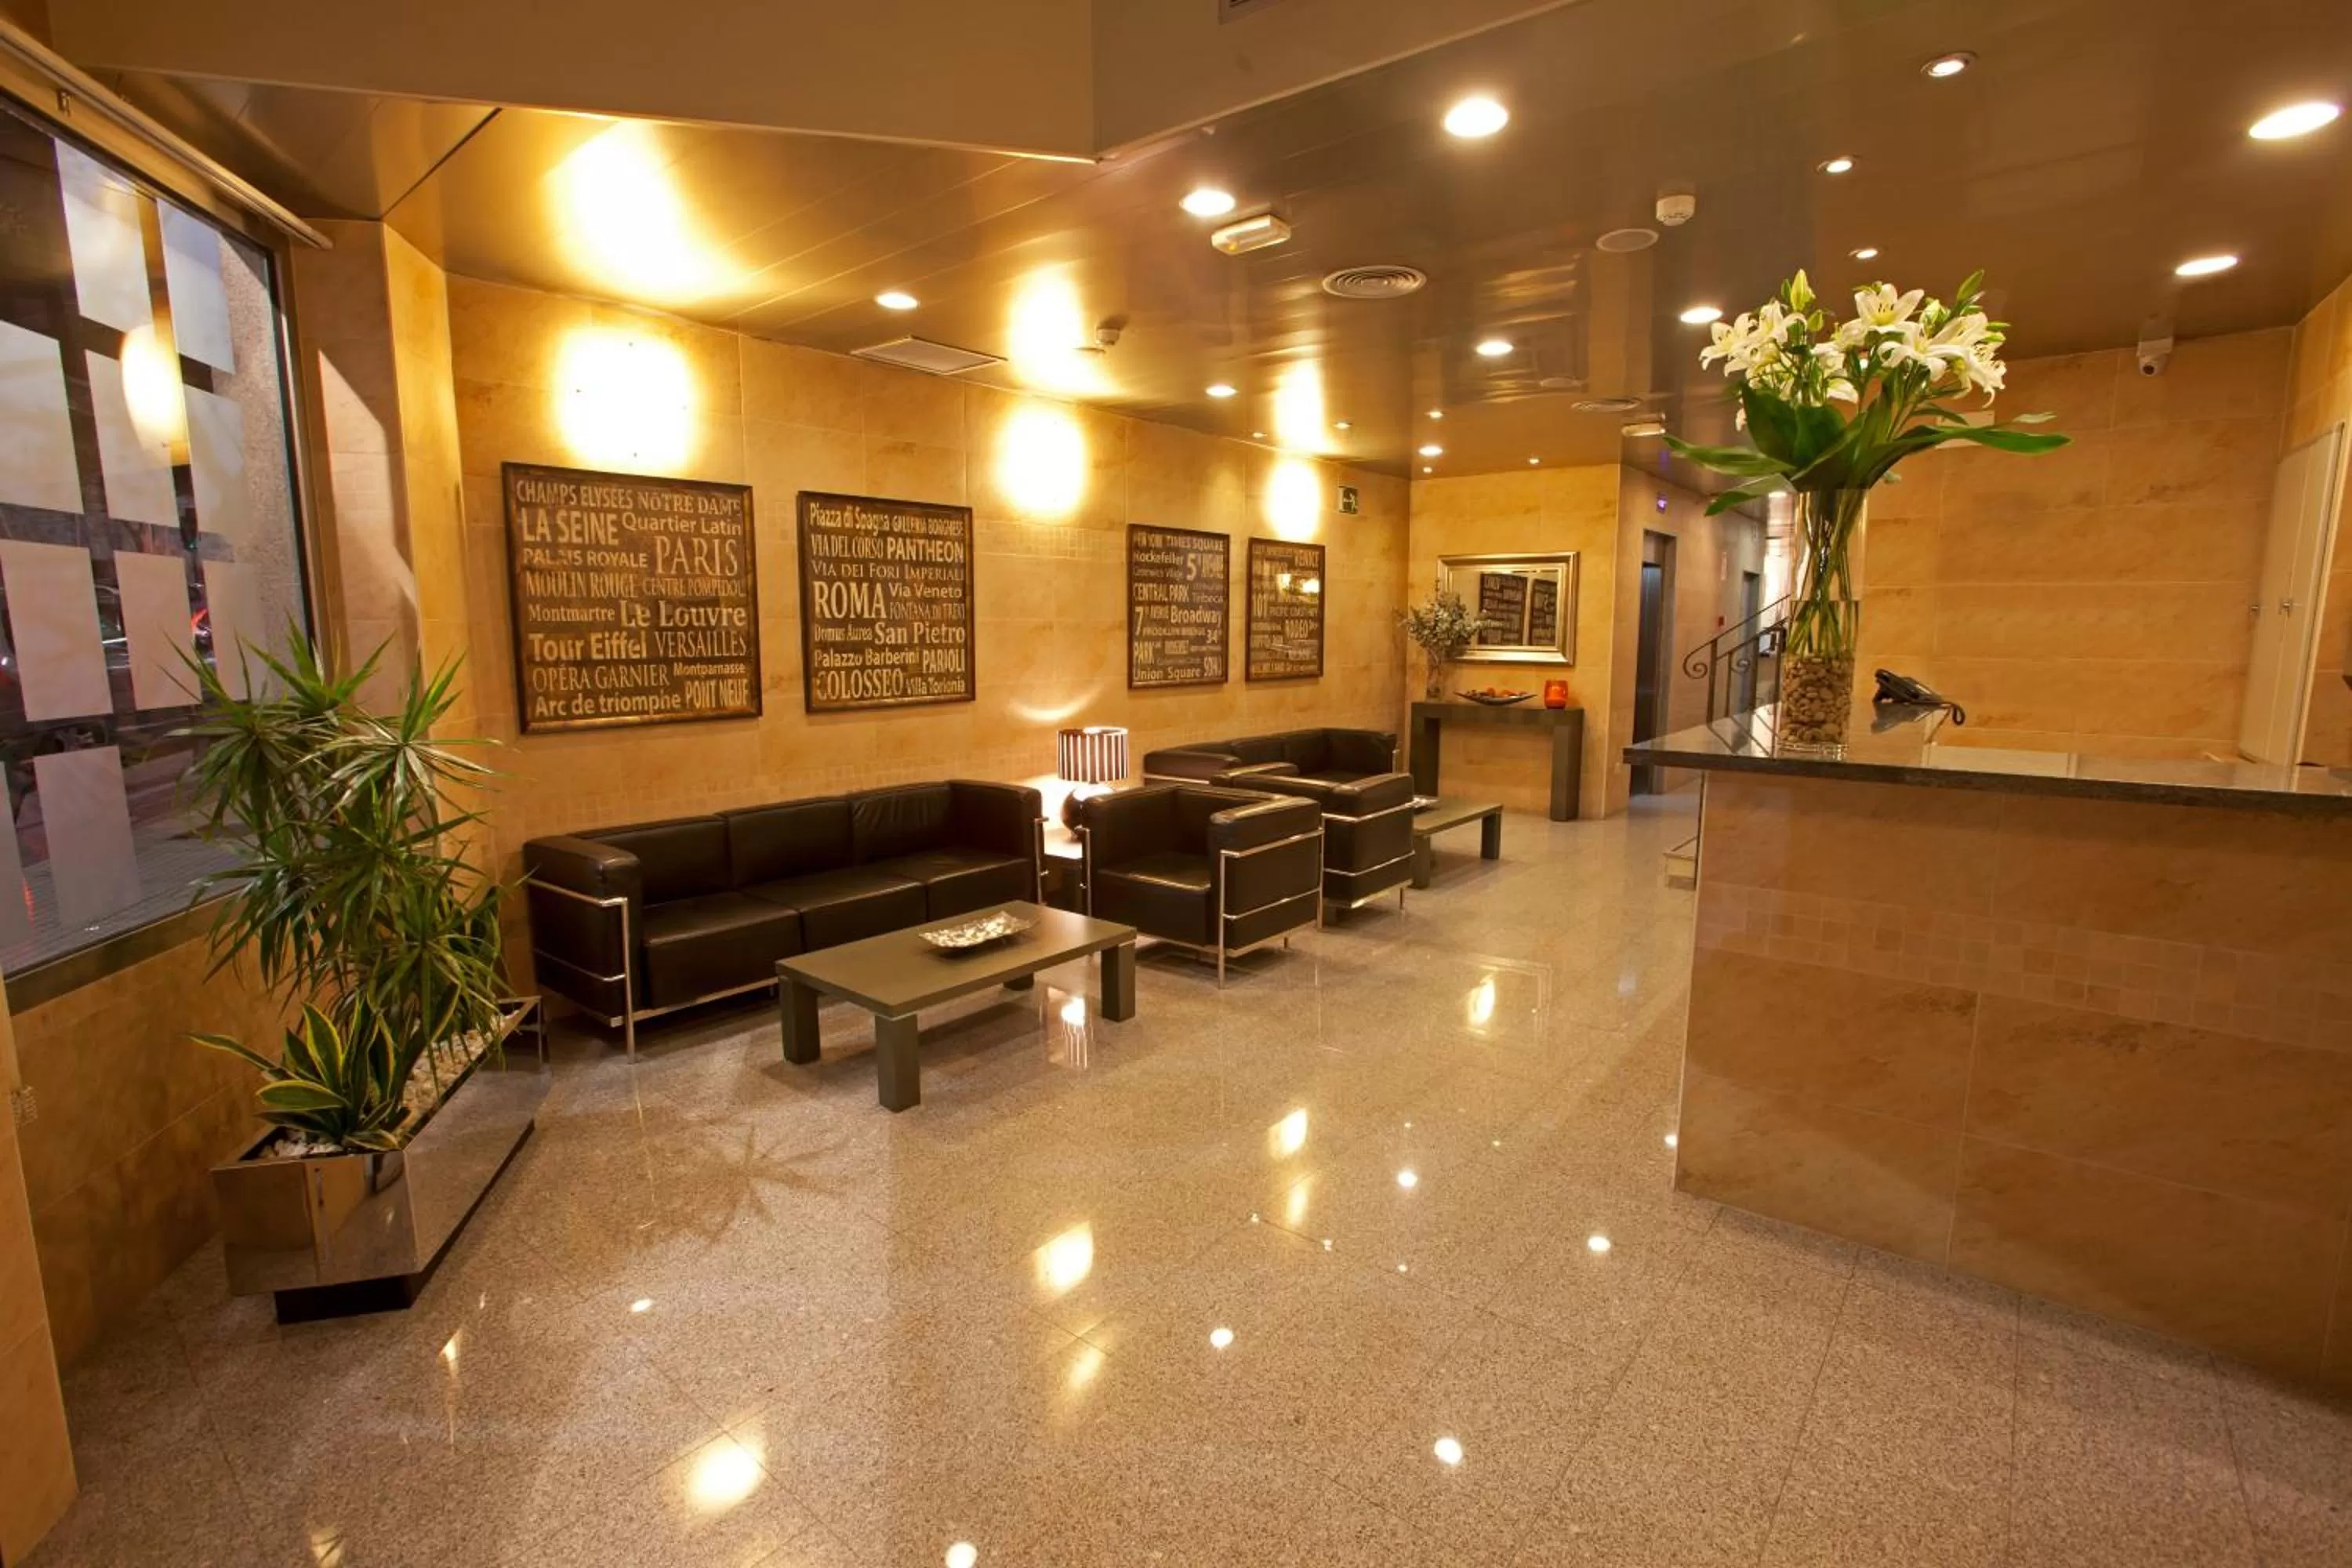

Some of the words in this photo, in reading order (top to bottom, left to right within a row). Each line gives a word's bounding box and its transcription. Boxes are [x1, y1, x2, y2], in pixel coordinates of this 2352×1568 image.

[517, 480, 578, 506] CHAMPS
[698, 496, 742, 516] DAME
[521, 507, 552, 543] LA
[555, 509, 619, 546] SEINE
[622, 511, 696, 533] Quartier
[700, 517, 742, 535] Latin
[809, 502, 842, 527] Piazza
[855, 506, 890, 536] Spagna
[523, 547, 583, 565] PALAIS
[587, 551, 649, 568] ROYALE
[653, 535, 738, 576] PARIS
[811, 534, 829, 557] VIA
[831, 535, 851, 557] DEL
[852, 536, 884, 559] CORSO
[887, 537, 964, 563] PANTHEON
[525, 570, 587, 597] MOULIN
[589, 571, 639, 598] ROUGE
[642, 576, 686, 597] CENTRE
[888, 582, 912, 597] Via
[913, 583, 963, 598] Veneto
[1133, 583, 1168, 603] CENTRAL
[1169, 584, 1189, 603] PARK
[528, 604, 615, 622] Montmartre
[813, 581, 887, 619] ROMA
[619, 600, 651, 627] Le
[659, 600, 746, 627] Louvre
[1171, 605, 1222, 627] Broadway
[528, 633, 585, 662] Tour
[590, 630, 647, 659] Eiffel
[654, 630, 746, 658] VERSAILLES
[874, 622, 908, 644] San
[913, 622, 965, 644] Pietro
[673, 662, 746, 677] Montparnasse
[815, 647, 862, 668] Palazzo
[865, 647, 920, 666] Barberini
[923, 648, 965, 674] PARIOLI
[595, 664, 670, 690] GARNIER
[817, 668, 903, 700] COLOSSEO
[906, 677, 927, 695] Villa
[1134, 666, 1163, 681] Union
[1167, 666, 1201, 681] Square
[535, 695, 567, 717] Arc
[572, 692, 595, 716] de
[598, 689, 681, 715] triomphe
[684, 679, 716, 709] PONT
[719, 678, 749, 706] NEUF
